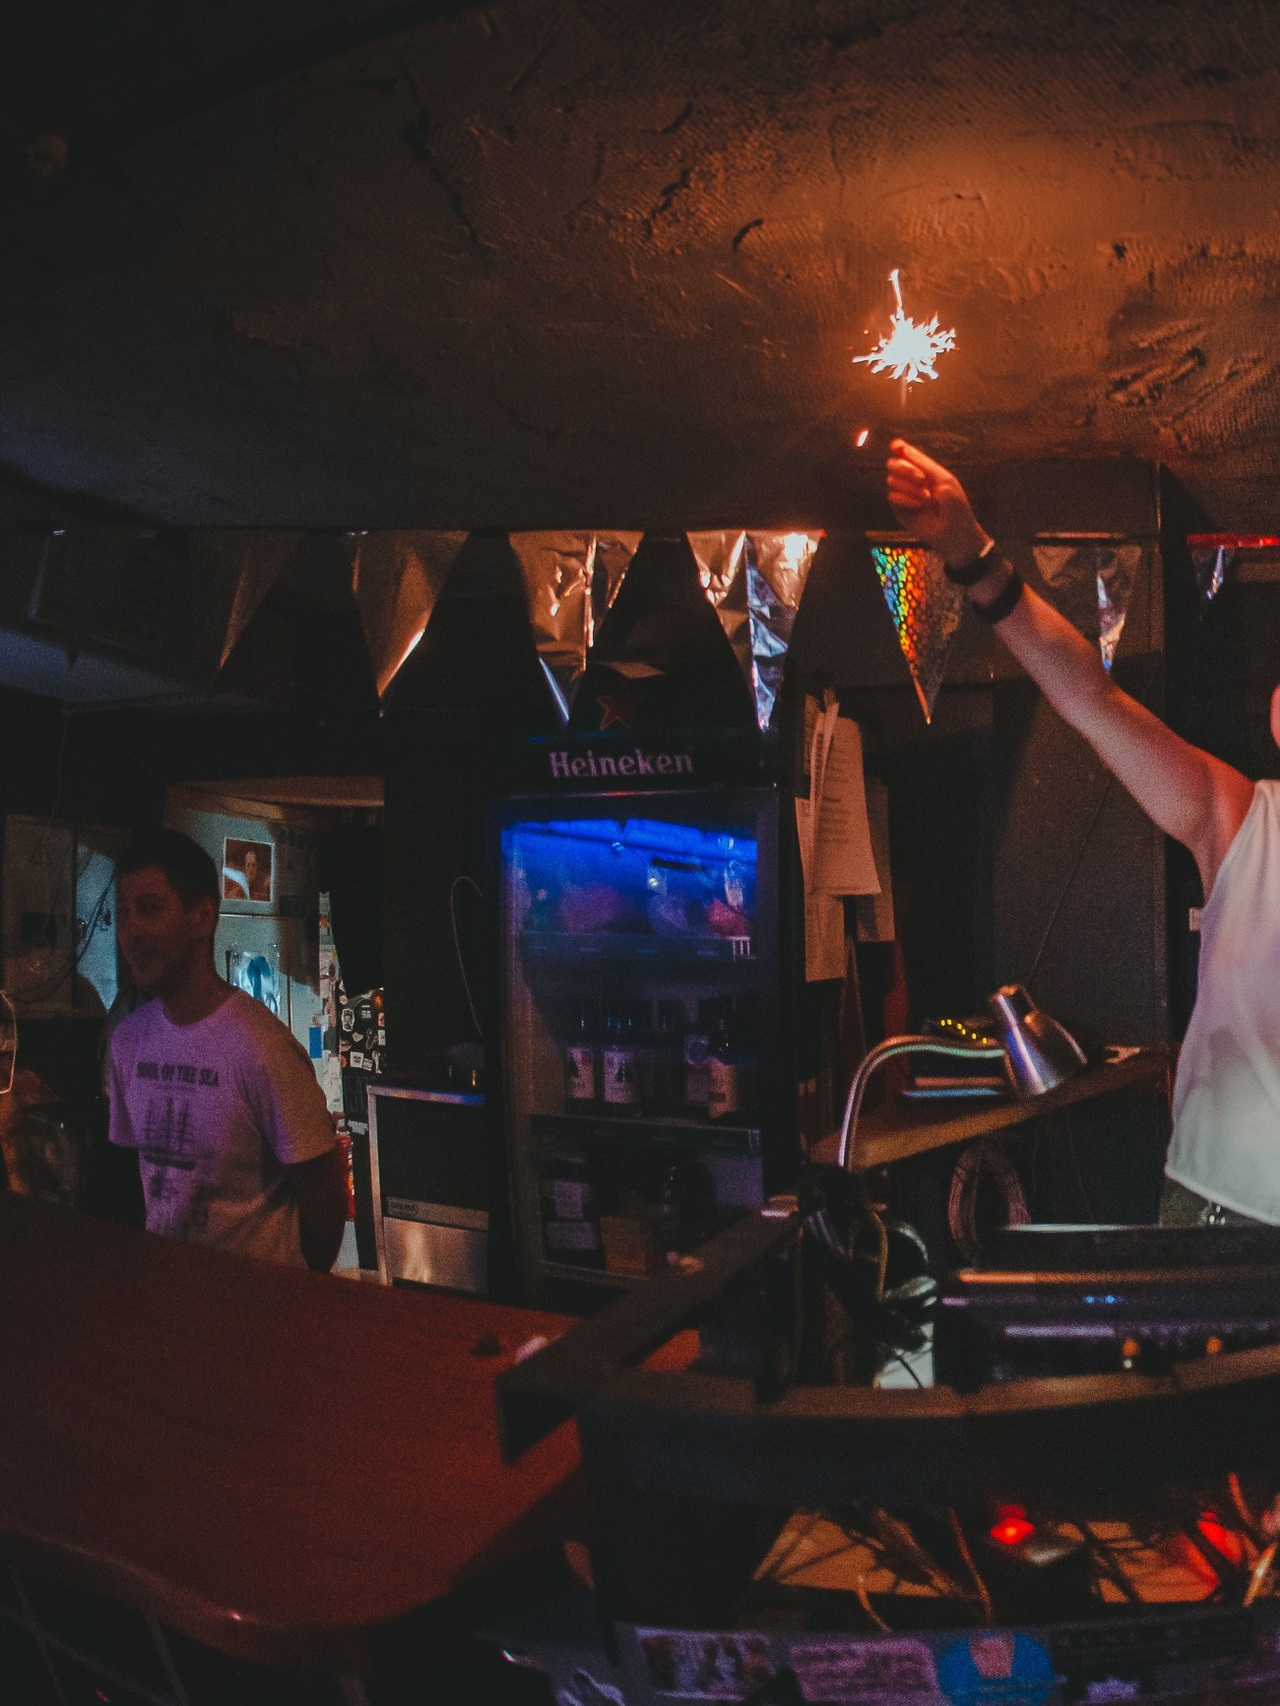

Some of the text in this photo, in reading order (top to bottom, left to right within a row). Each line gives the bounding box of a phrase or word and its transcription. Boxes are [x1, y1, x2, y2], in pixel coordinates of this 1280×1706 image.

[549, 748, 694, 779] Heineken
[161, 1063, 176, 1082] OF
[177, 1065, 198, 1084] THE
[199, 1068, 219, 1088] SEA
